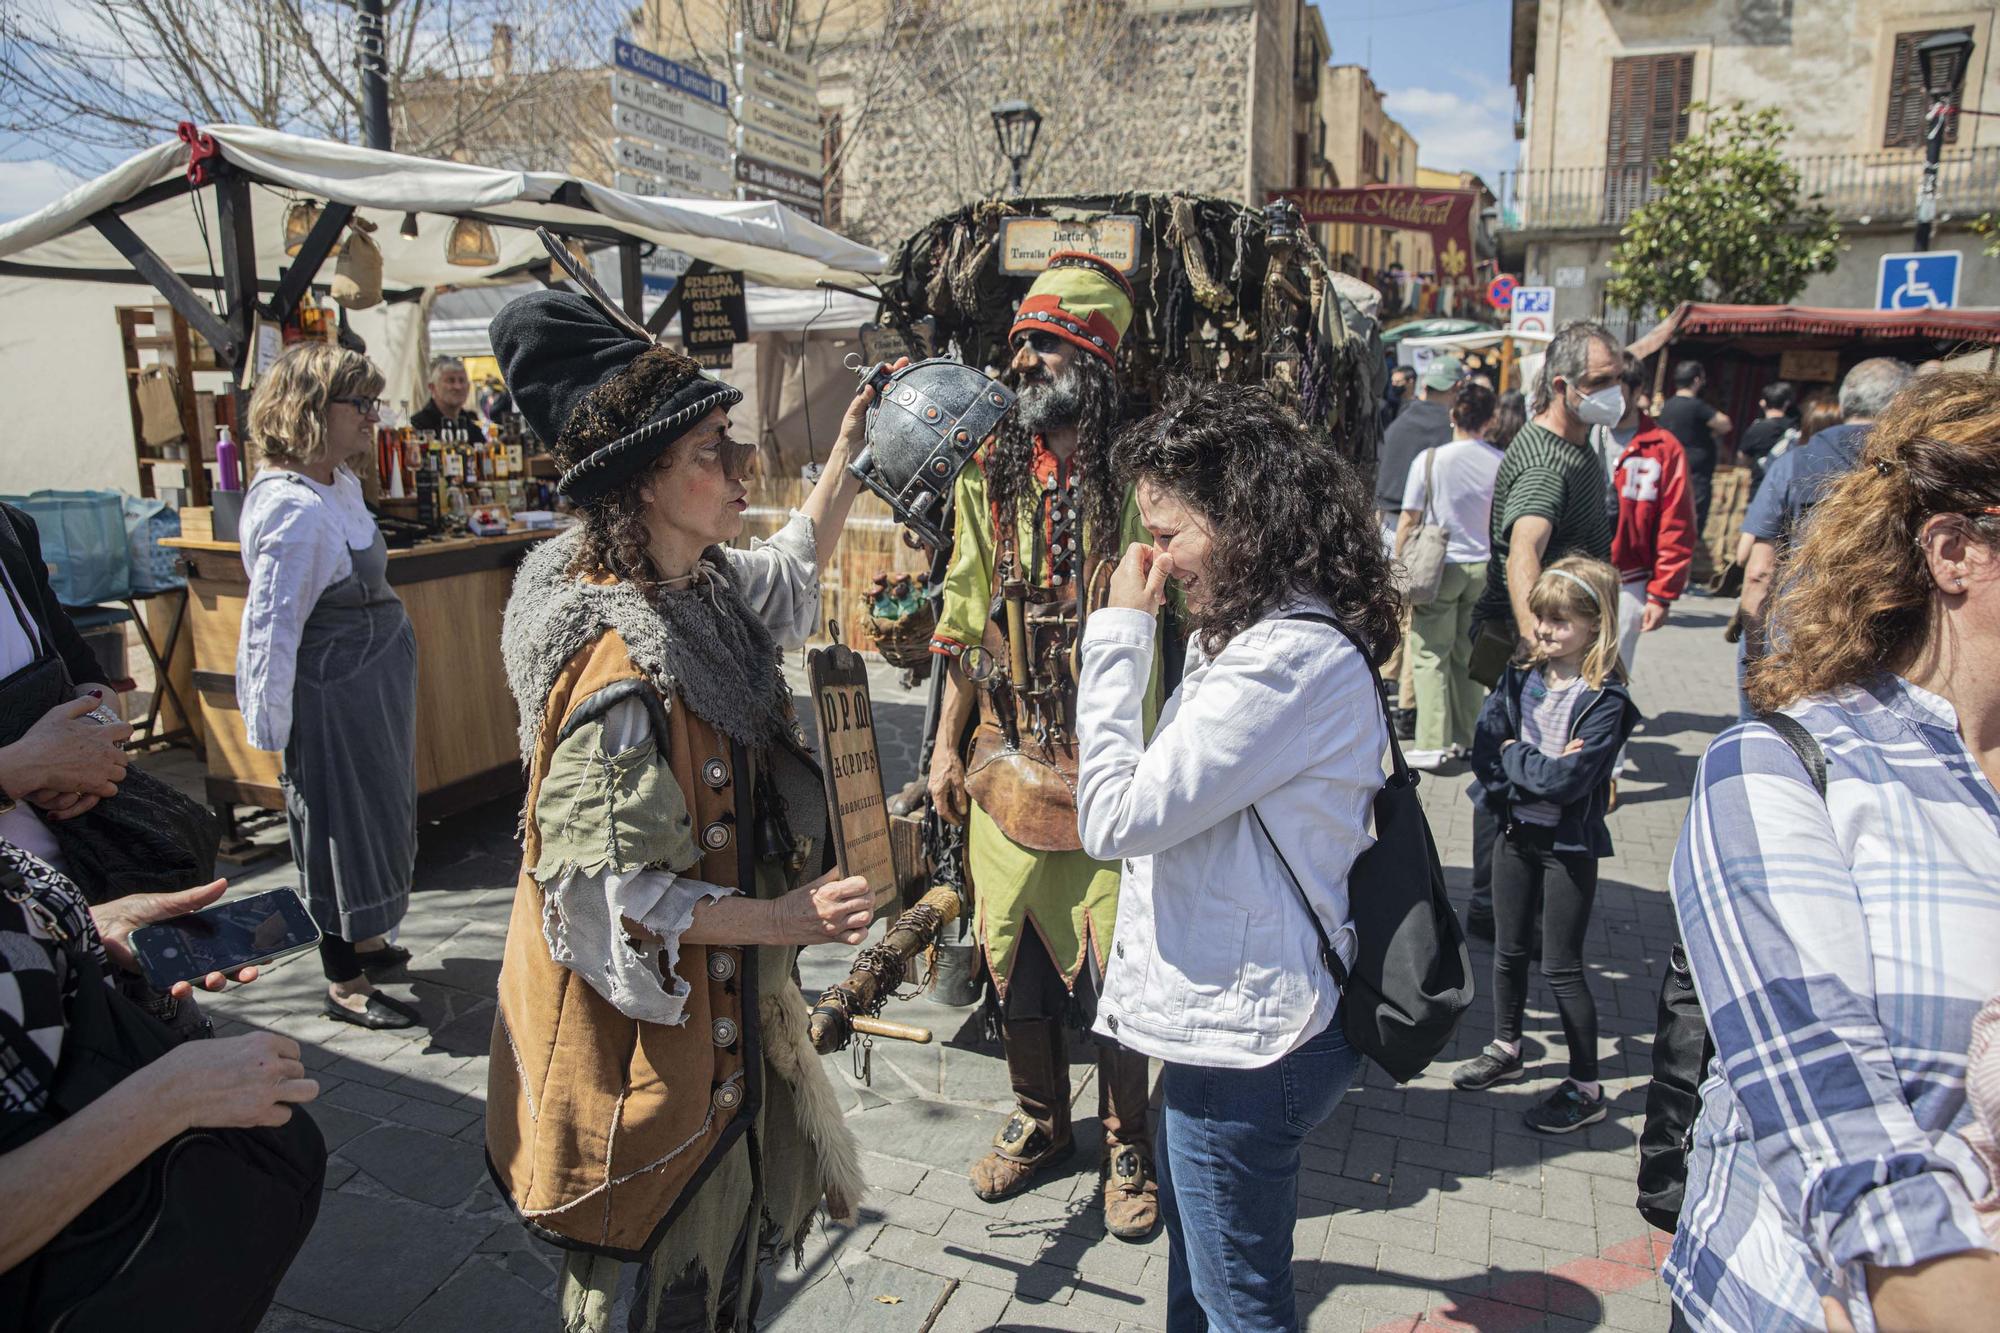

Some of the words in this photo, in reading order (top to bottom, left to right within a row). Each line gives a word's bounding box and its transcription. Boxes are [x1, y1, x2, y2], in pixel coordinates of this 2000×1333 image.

[630, 47, 664, 77] Oficina
[665, 62, 678, 83] de
[634, 84, 684, 116] Ajuntament
[646, 117, 675, 142] Cultural
[634, 149, 663, 173] Domus
[1053, 231, 1084, 242] Doctor
[684, 274, 734, 288] GINEBRA
[682, 284, 742, 299] ARTESANA
[692, 300, 722, 313] ORDI
[690, 329, 737, 343] ESPELTA
[1621, 456, 1661, 502] R
